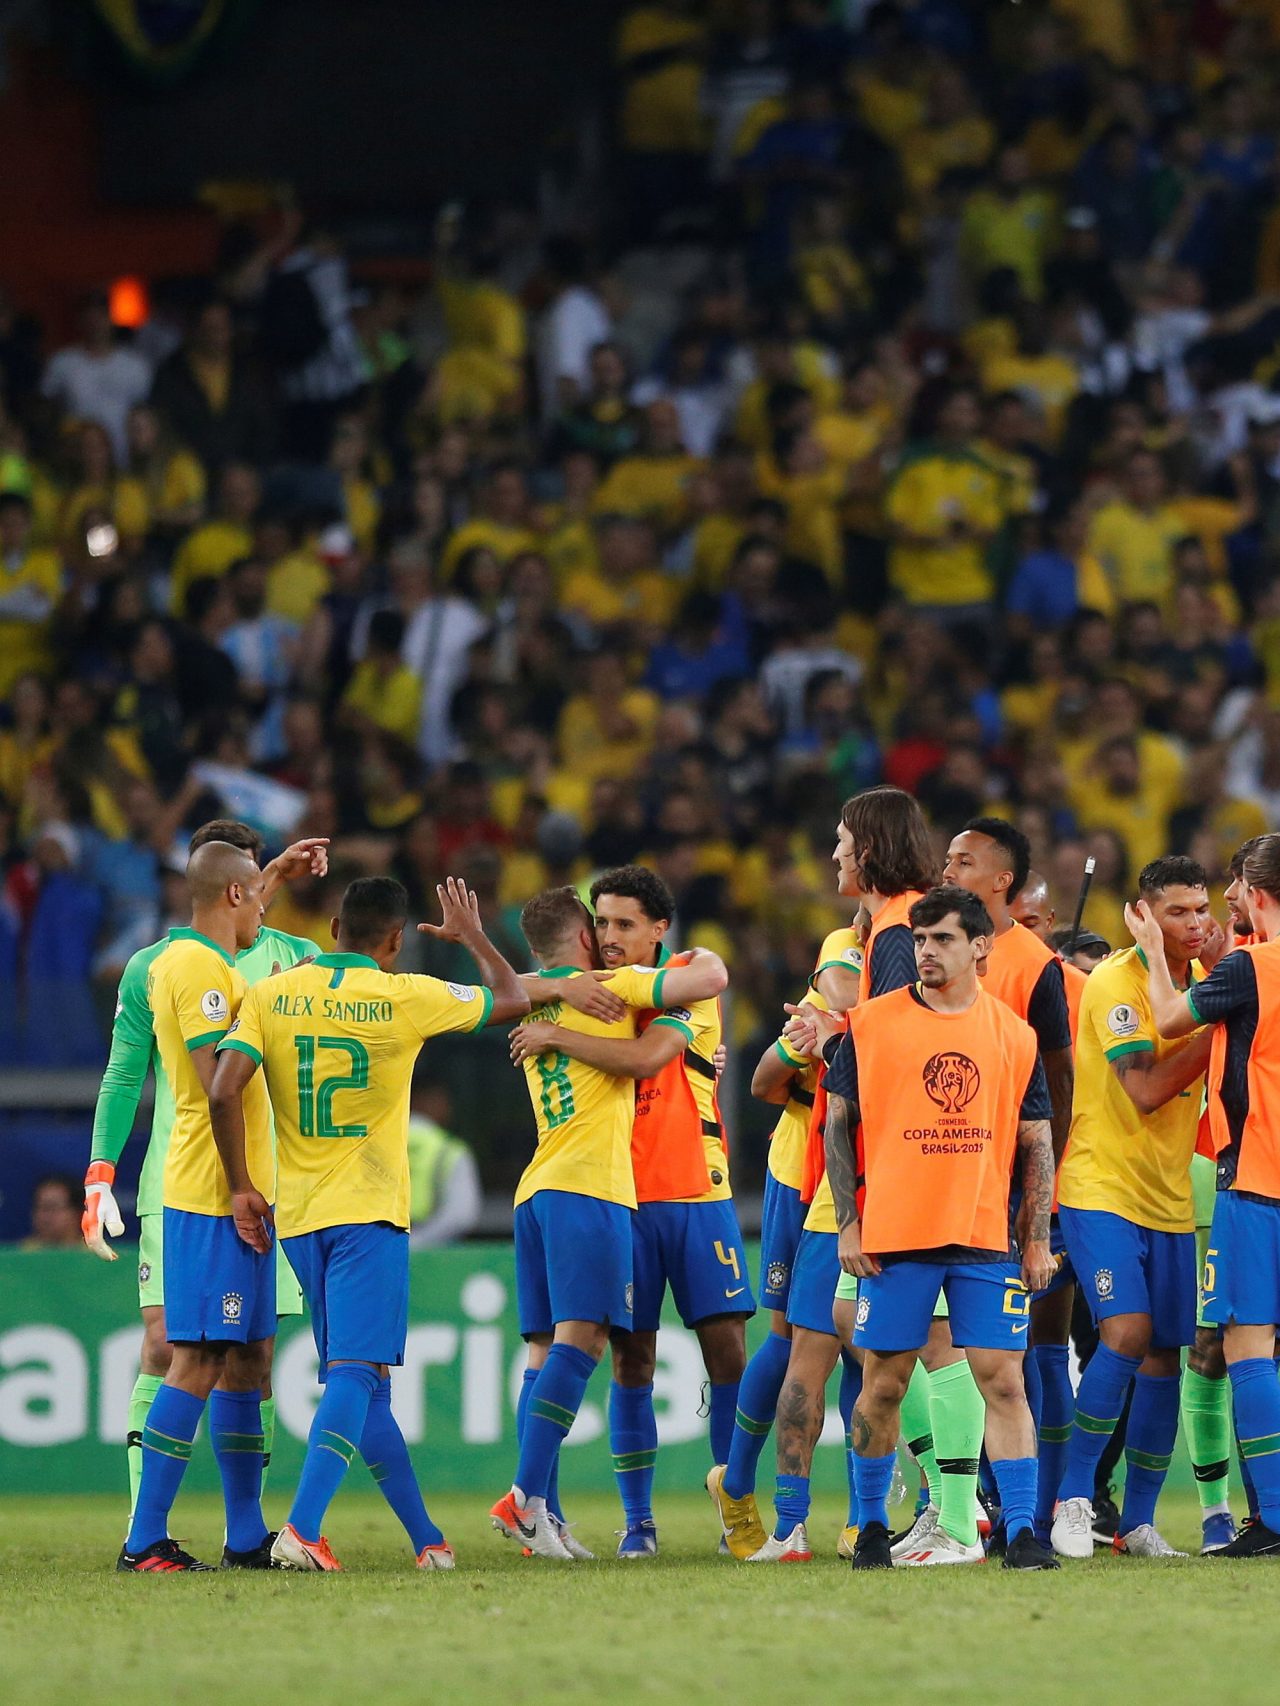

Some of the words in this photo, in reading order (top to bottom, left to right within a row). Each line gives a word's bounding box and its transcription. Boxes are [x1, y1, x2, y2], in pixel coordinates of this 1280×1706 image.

[272, 994, 315, 1017] ALEX
[322, 999, 393, 1023] SANDRO
[294, 1034, 369, 1138] 12
[535, 1048, 575, 1130] 8
[903, 1129, 939, 1140] COPA
[941, 1128, 992, 1141] AMERIA
[938, 1118, 968, 1126] CONMEBOL
[960, 1143, 984, 1154] 2019
[713, 1240, 741, 1280] 4
